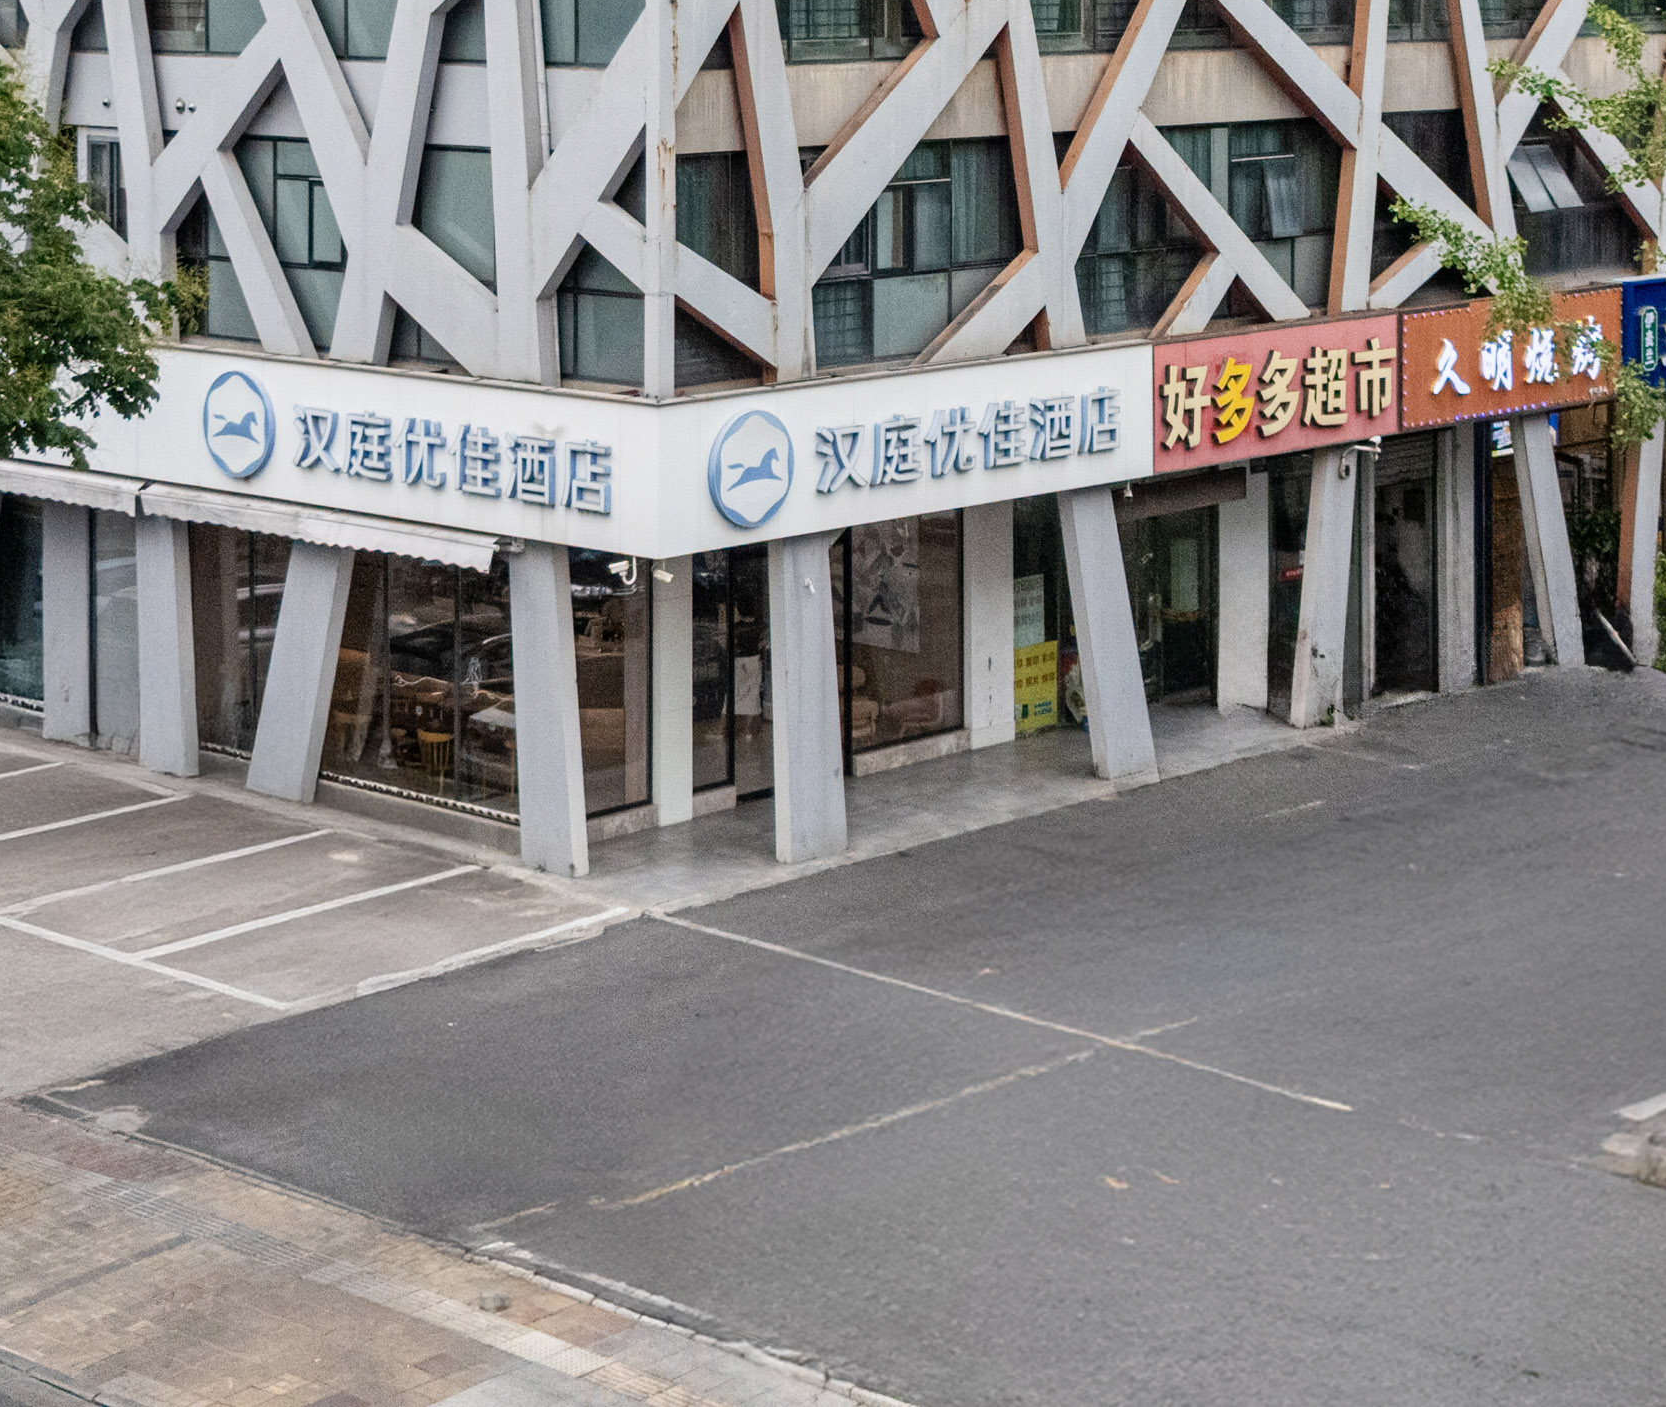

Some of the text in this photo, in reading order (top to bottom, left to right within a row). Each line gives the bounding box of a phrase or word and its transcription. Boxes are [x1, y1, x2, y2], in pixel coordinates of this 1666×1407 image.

[815, 386, 1122, 494] 汉庭优佳酒店
[1161, 337, 1397, 451] 好多多超市
[294, 404, 612, 515] 汉庭优佳酒店
